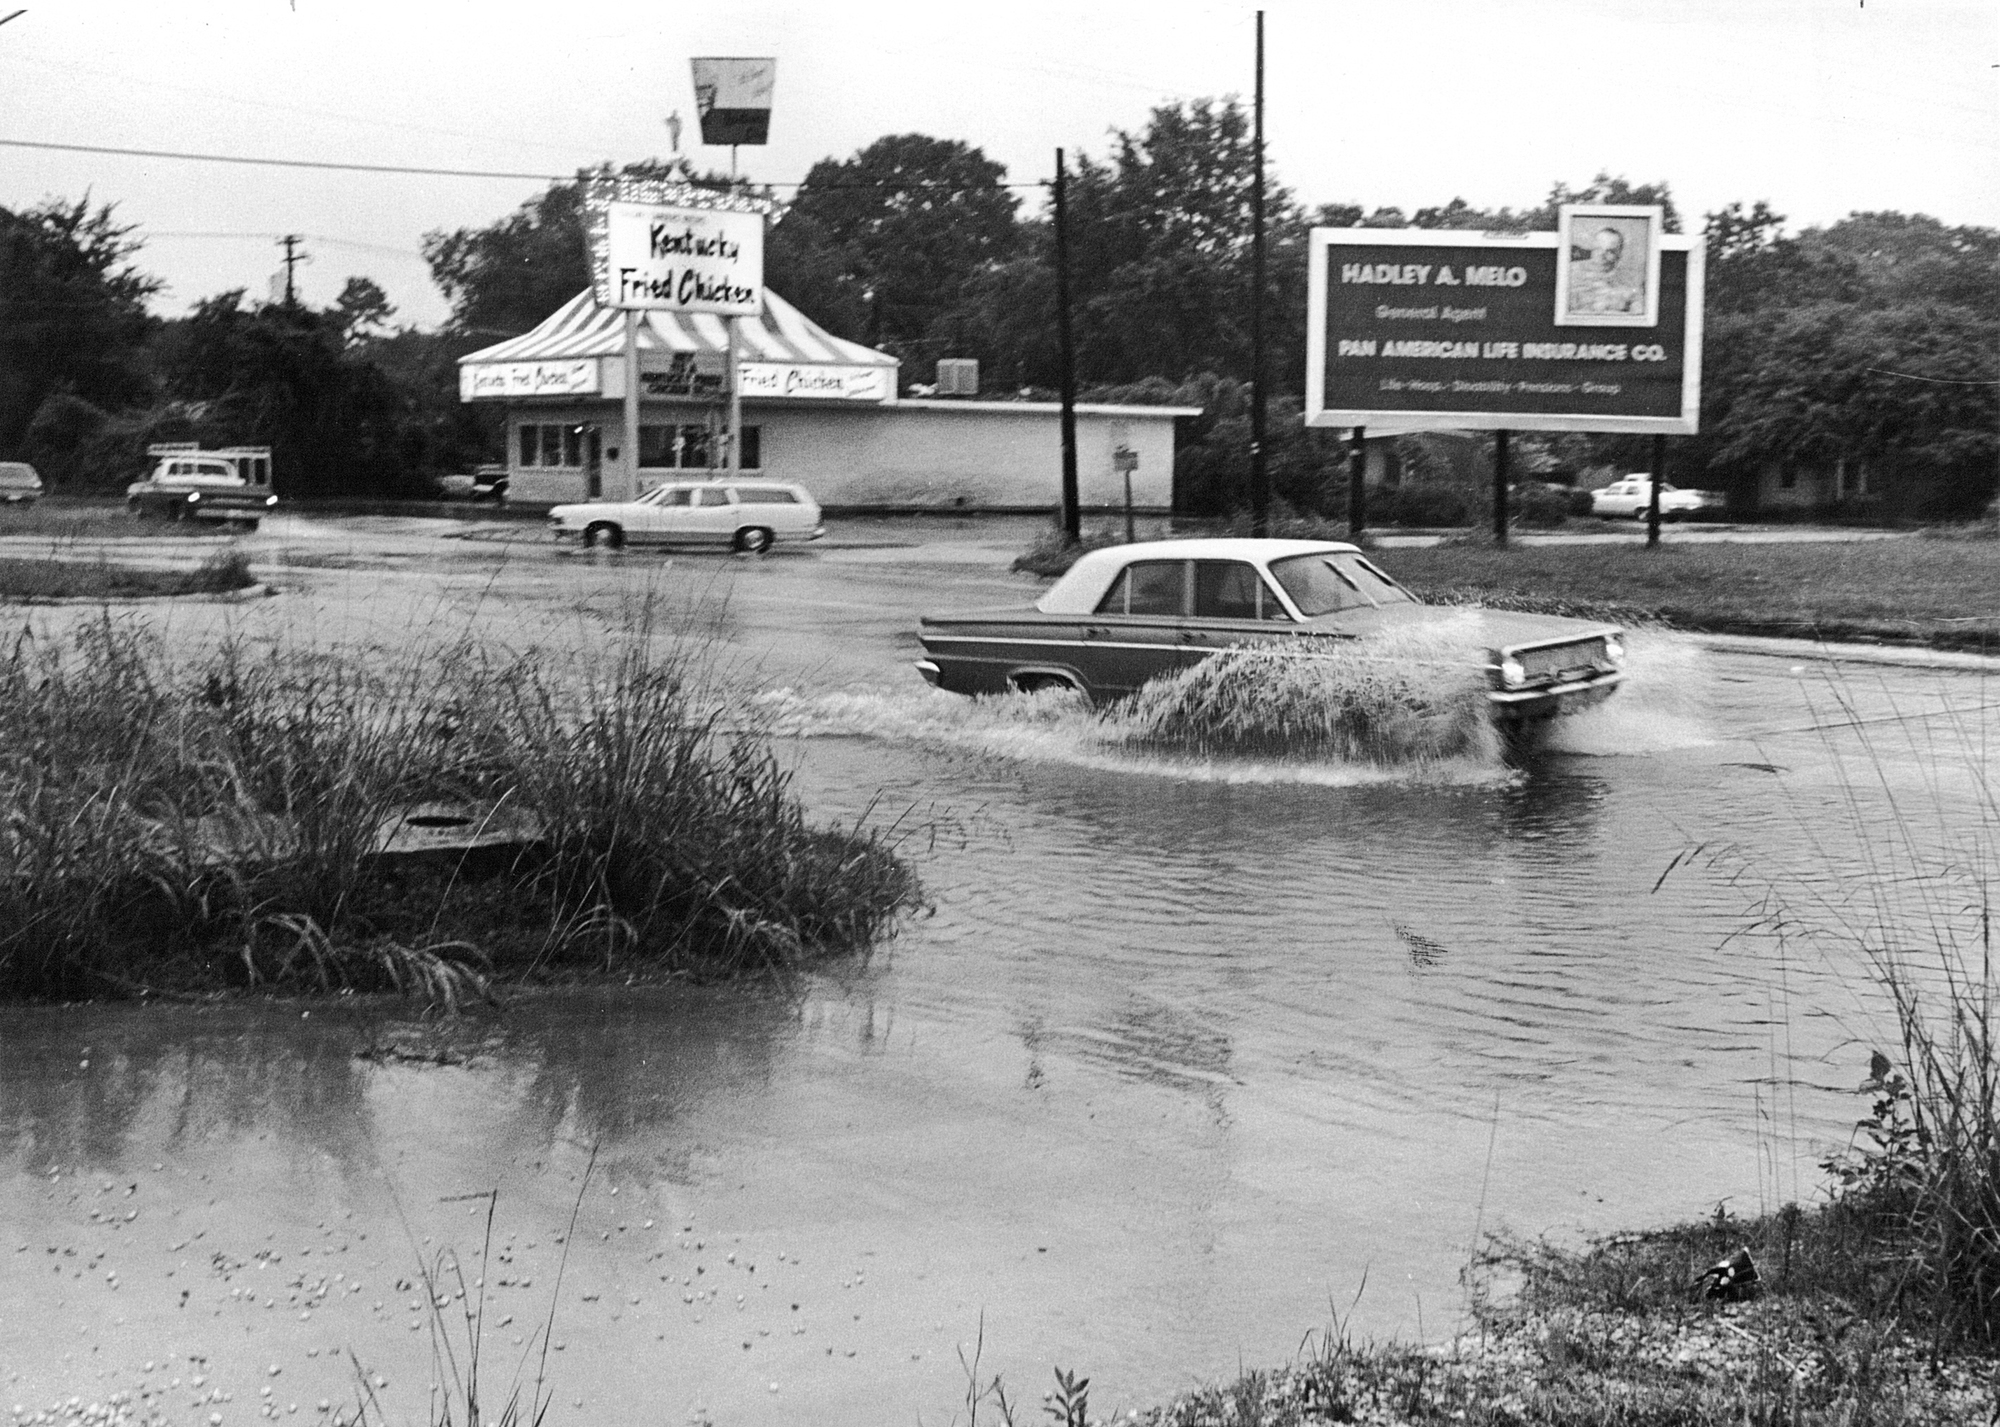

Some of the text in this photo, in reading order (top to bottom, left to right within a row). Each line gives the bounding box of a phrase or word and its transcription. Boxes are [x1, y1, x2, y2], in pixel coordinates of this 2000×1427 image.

[650, 223, 740, 264] Kentucky
[620, 267, 755, 305] Fried Chicken
[1341, 262, 1527, 288] HADLEY A. MELO
[1338, 339, 1668, 362] PAN AMERICAN LIFE INSURANCE CO.
[785, 368, 844, 397] Chicken
